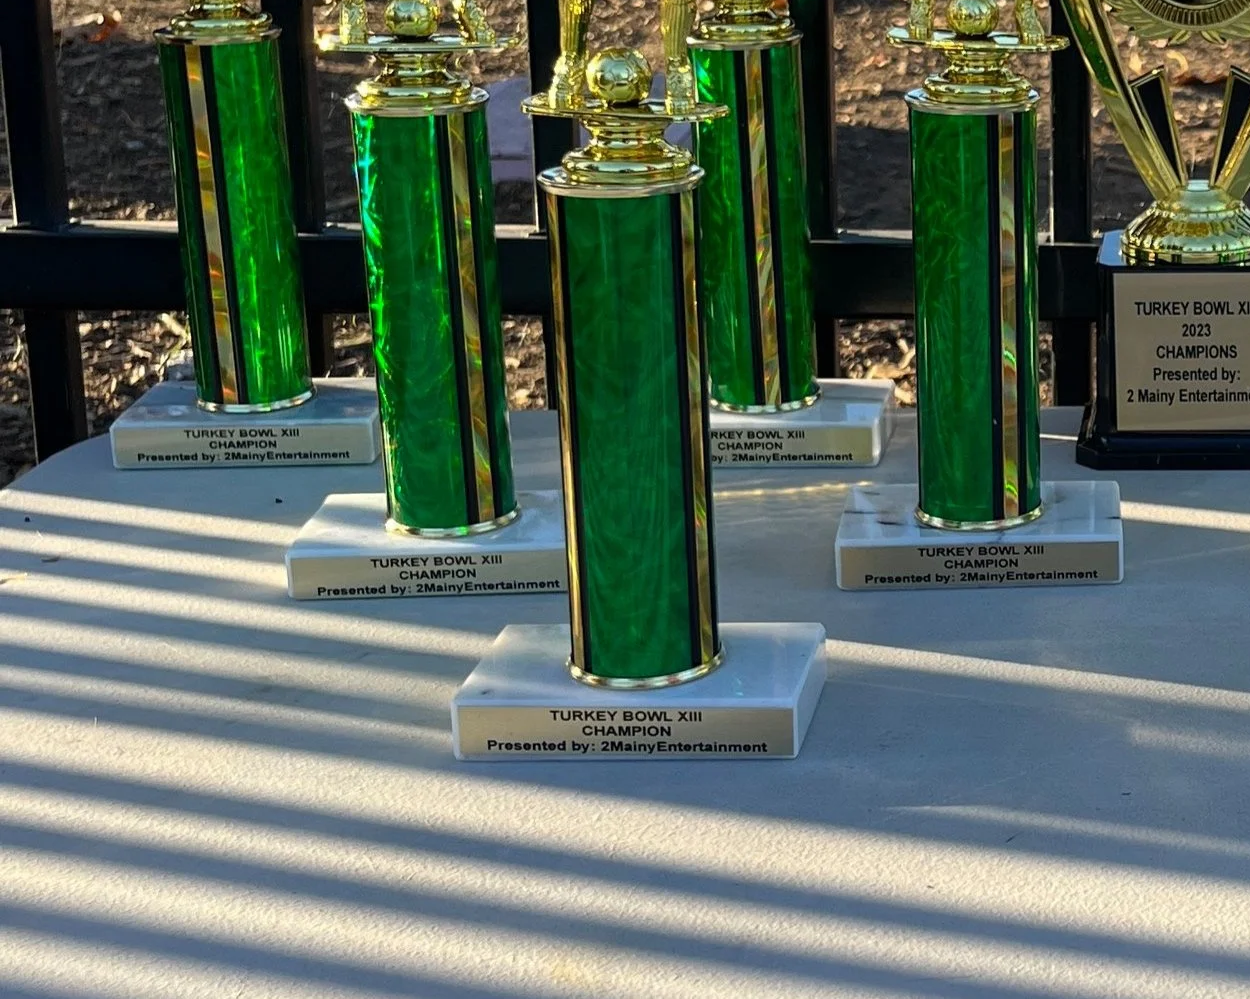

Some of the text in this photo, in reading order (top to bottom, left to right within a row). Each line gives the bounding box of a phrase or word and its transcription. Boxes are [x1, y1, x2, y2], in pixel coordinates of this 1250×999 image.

[1135, 302, 1189, 316] TURKEY
[1194, 302, 1233, 315] BOWL
[1182, 324, 1211, 337] 2023
[1157, 345, 1237, 359] CHAMPIONS
[1153, 368, 1241, 383] Presented by:
[1127, 389, 1134, 403] 2
[1138, 389, 1175, 405] Mainy
[184, 428, 299, 439] TURKEY BOWL XIII
[710, 431, 804, 439] RKEY BOWL XIII
[209, 440, 277, 449] CHAMPION
[718, 442, 783, 450] CHAMPION
[137, 451, 350, 463] Presented by: 2MainyEntertainment
[732, 453, 853, 463] 2MainyEntertainment
[918, 546, 1044, 557] TURKEY BOWL XIII
[370, 555, 502, 568] TURKEY BOWL XIII
[944, 558, 1018, 569] CHAMPION
[400, 568, 476, 580] CHAMPION
[865, 570, 1098, 584] Presented by: 2MainyEntertainment
[318, 580, 560, 596] Presented by: 2MainyEntertainment
[550, 711, 702, 722] TURKEY BOWL XIII
[582, 726, 671, 737] CHAMPION
[488, 740, 768, 754] Presented by: 2MainyEntertainment
